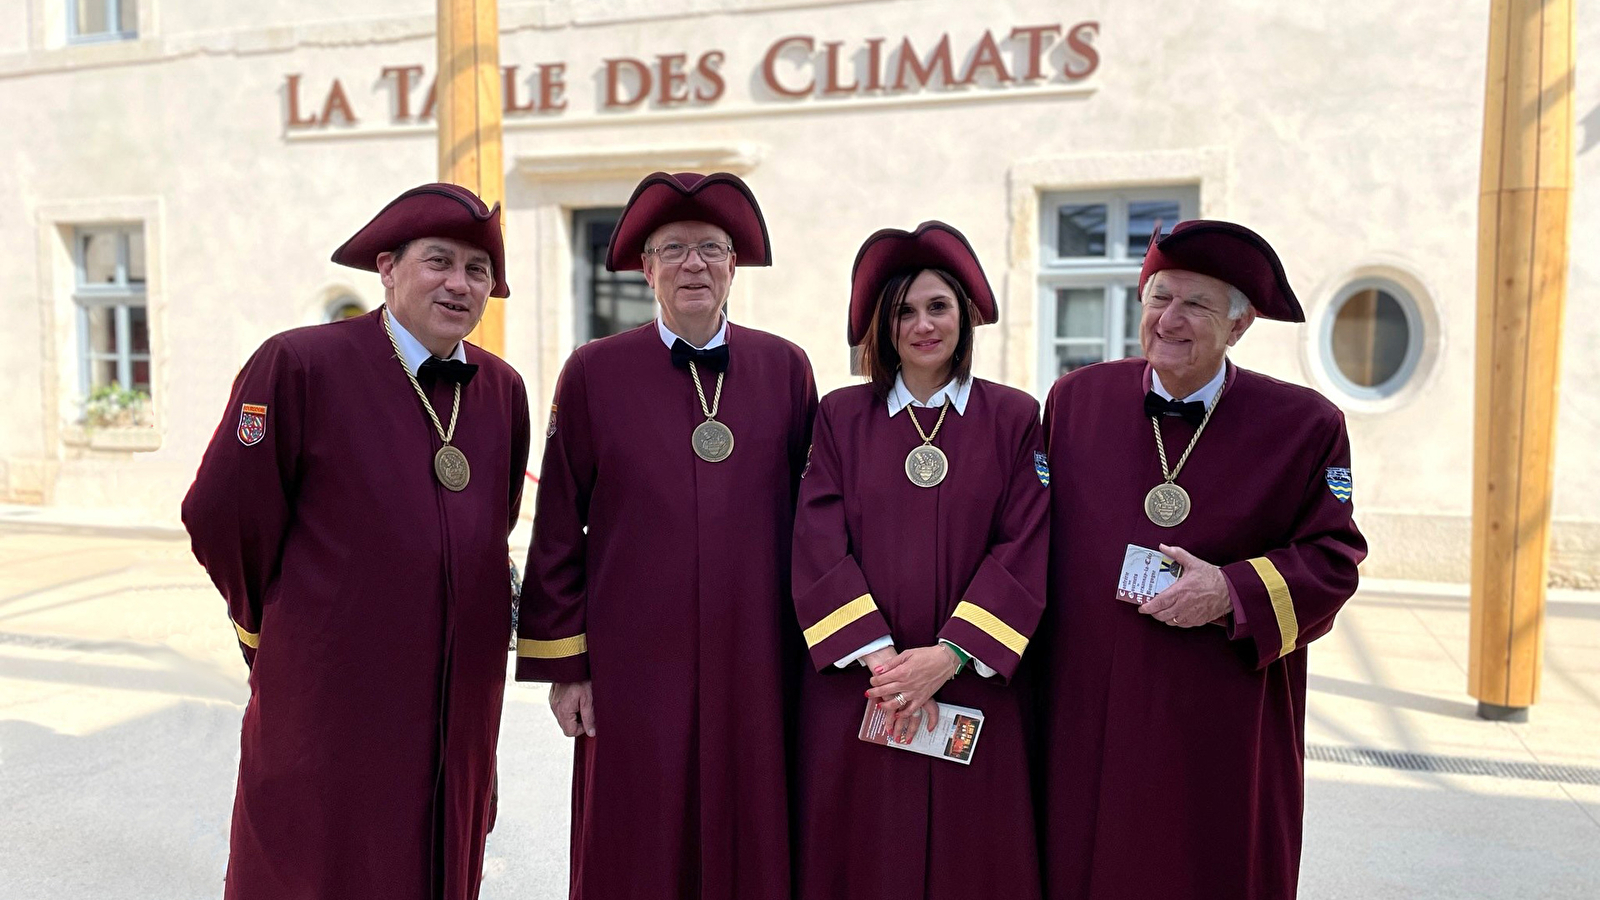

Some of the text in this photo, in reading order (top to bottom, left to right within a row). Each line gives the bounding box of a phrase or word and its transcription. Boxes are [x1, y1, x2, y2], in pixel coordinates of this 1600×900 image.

[285, 21, 1100, 128] LA TLE DES CLIMATS
